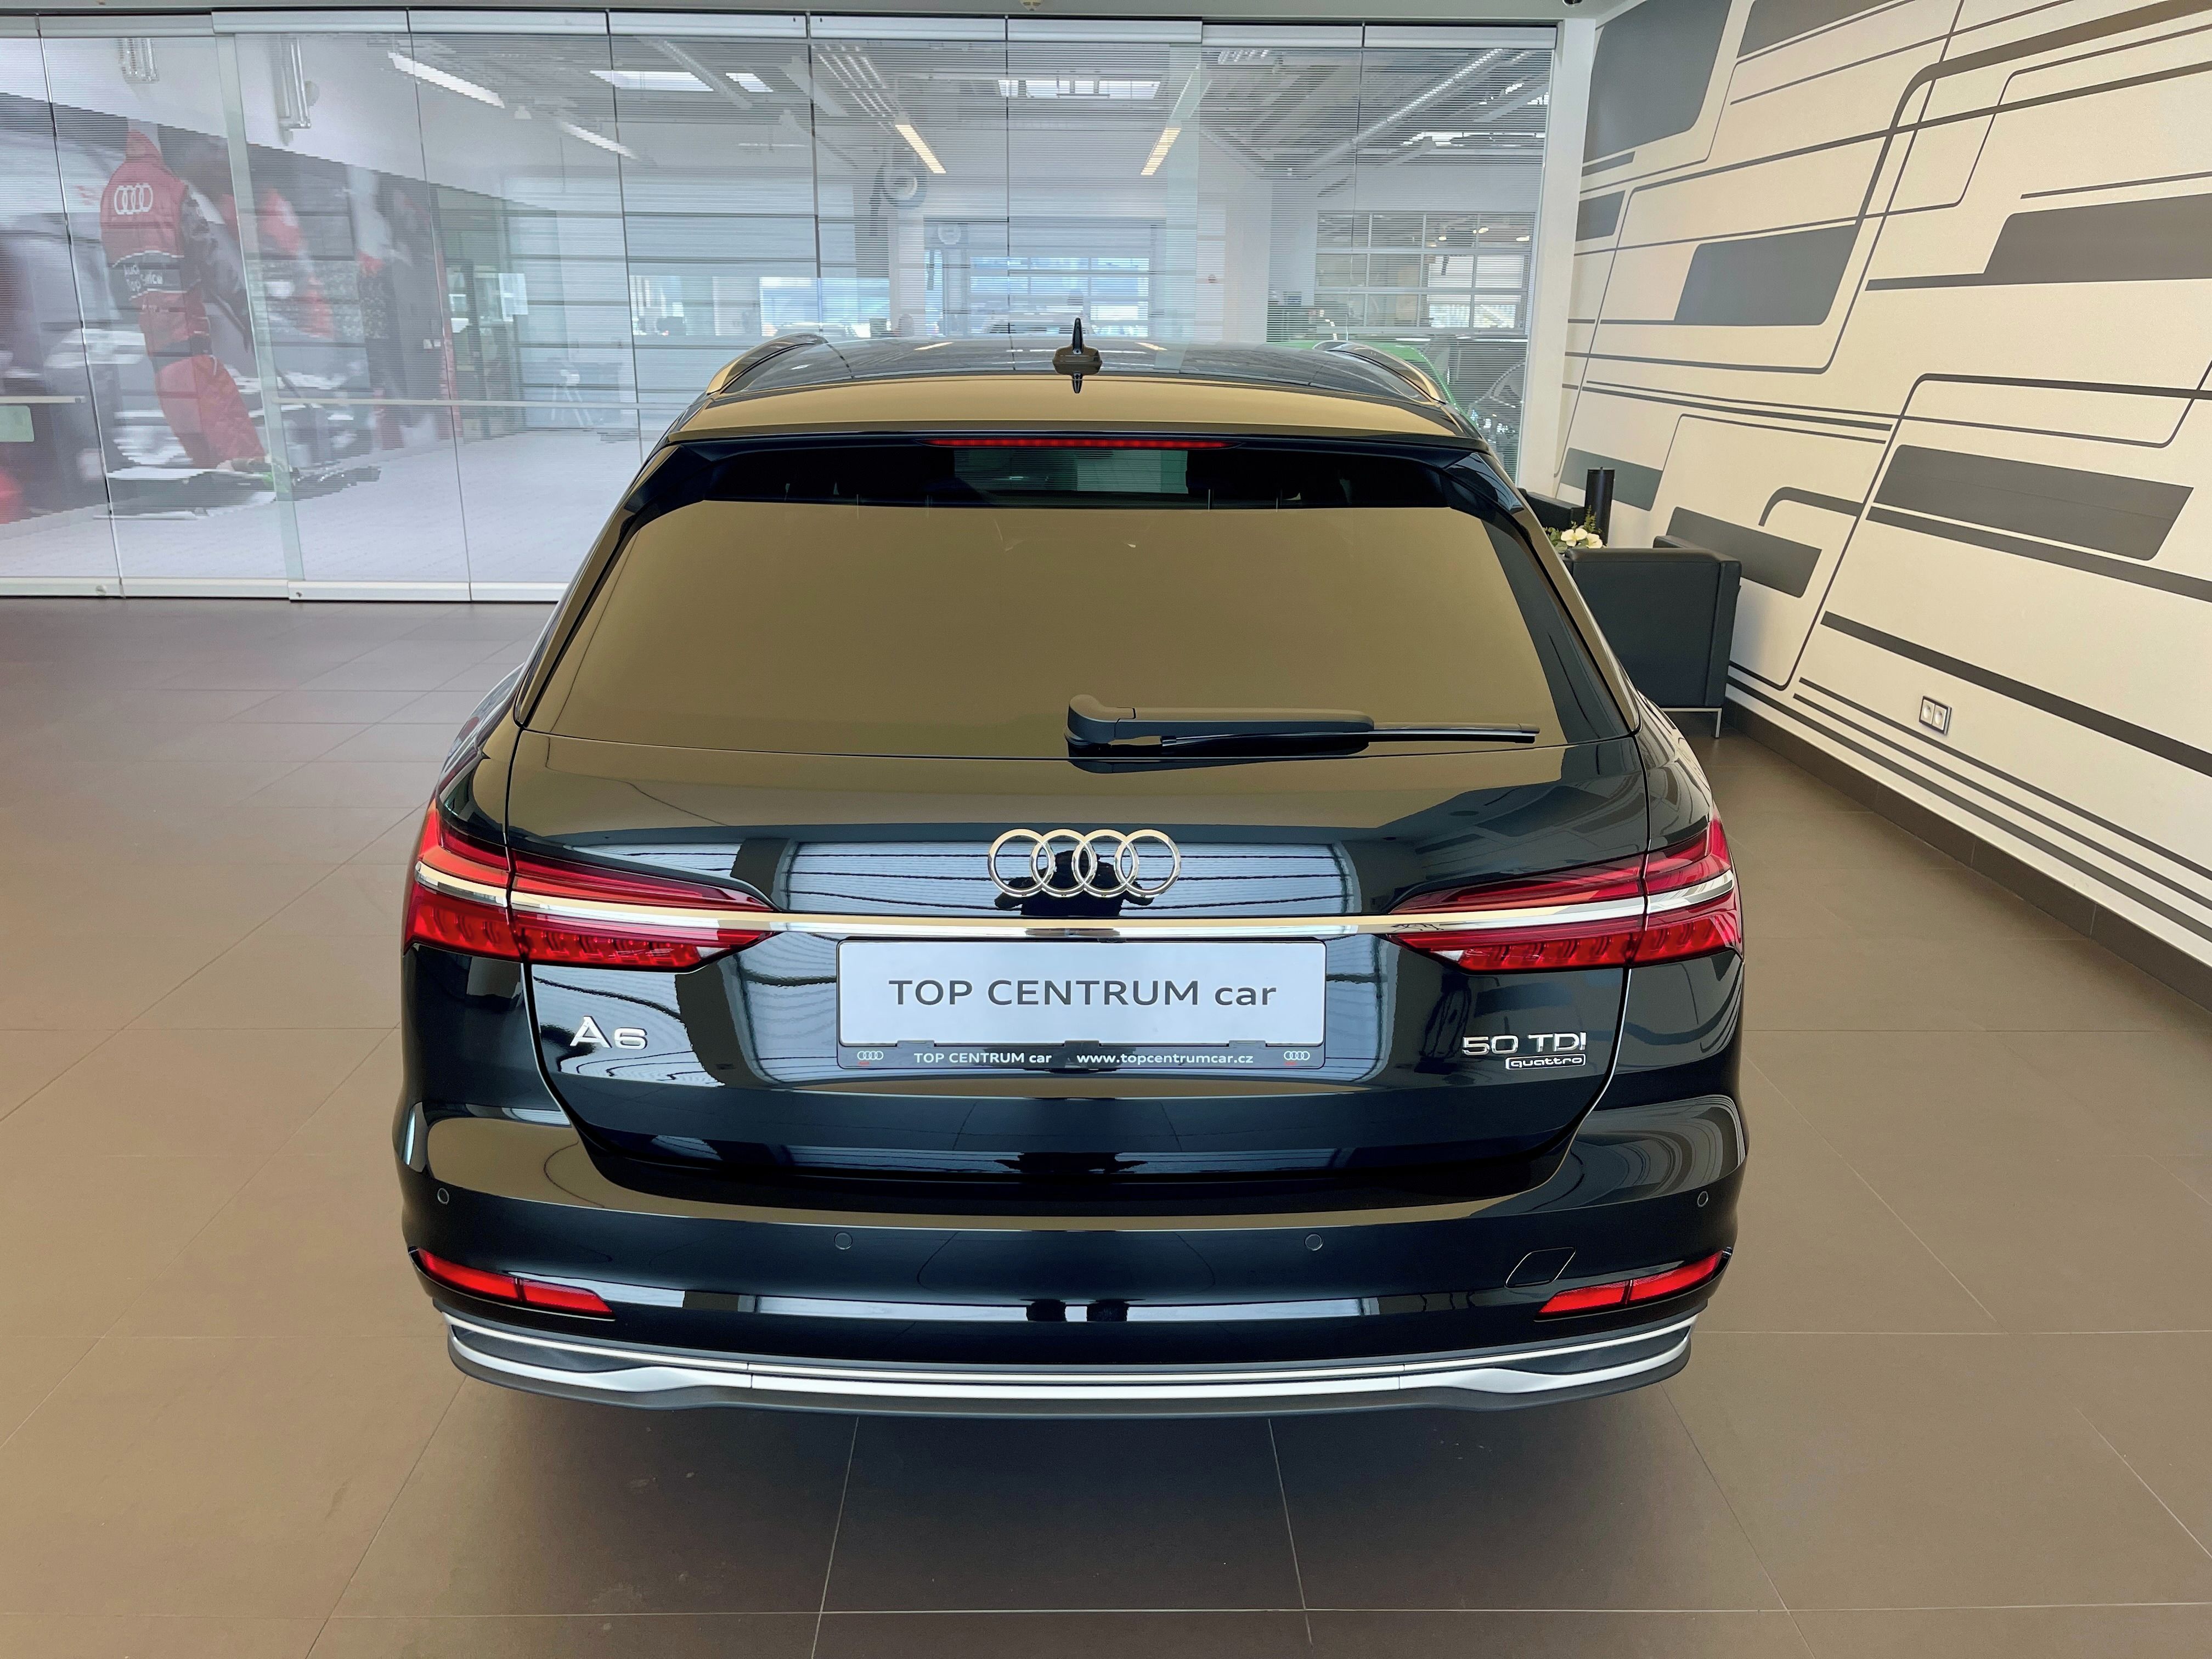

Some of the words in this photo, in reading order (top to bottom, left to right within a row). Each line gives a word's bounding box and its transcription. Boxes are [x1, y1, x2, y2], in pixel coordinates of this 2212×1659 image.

[888, 980, 973, 1006] TOP
[988, 980, 1199, 1006] CENTRUM
[1214, 986, 1277, 1006] car
[569, 1015, 648, 1050] A6
[1462, 1035, 1519, 1056] 50
[1527, 1031, 1587, 1052] TDI
[913, 1052, 945, 1063] TOP
[949, 1052, 1025, 1063] CENTRUM
[1028, 1054, 1052, 1063] car
[1076, 1053, 1254, 1065] www.topcentrumcar.cz
[1510, 1057, 1583, 1068] quattro
